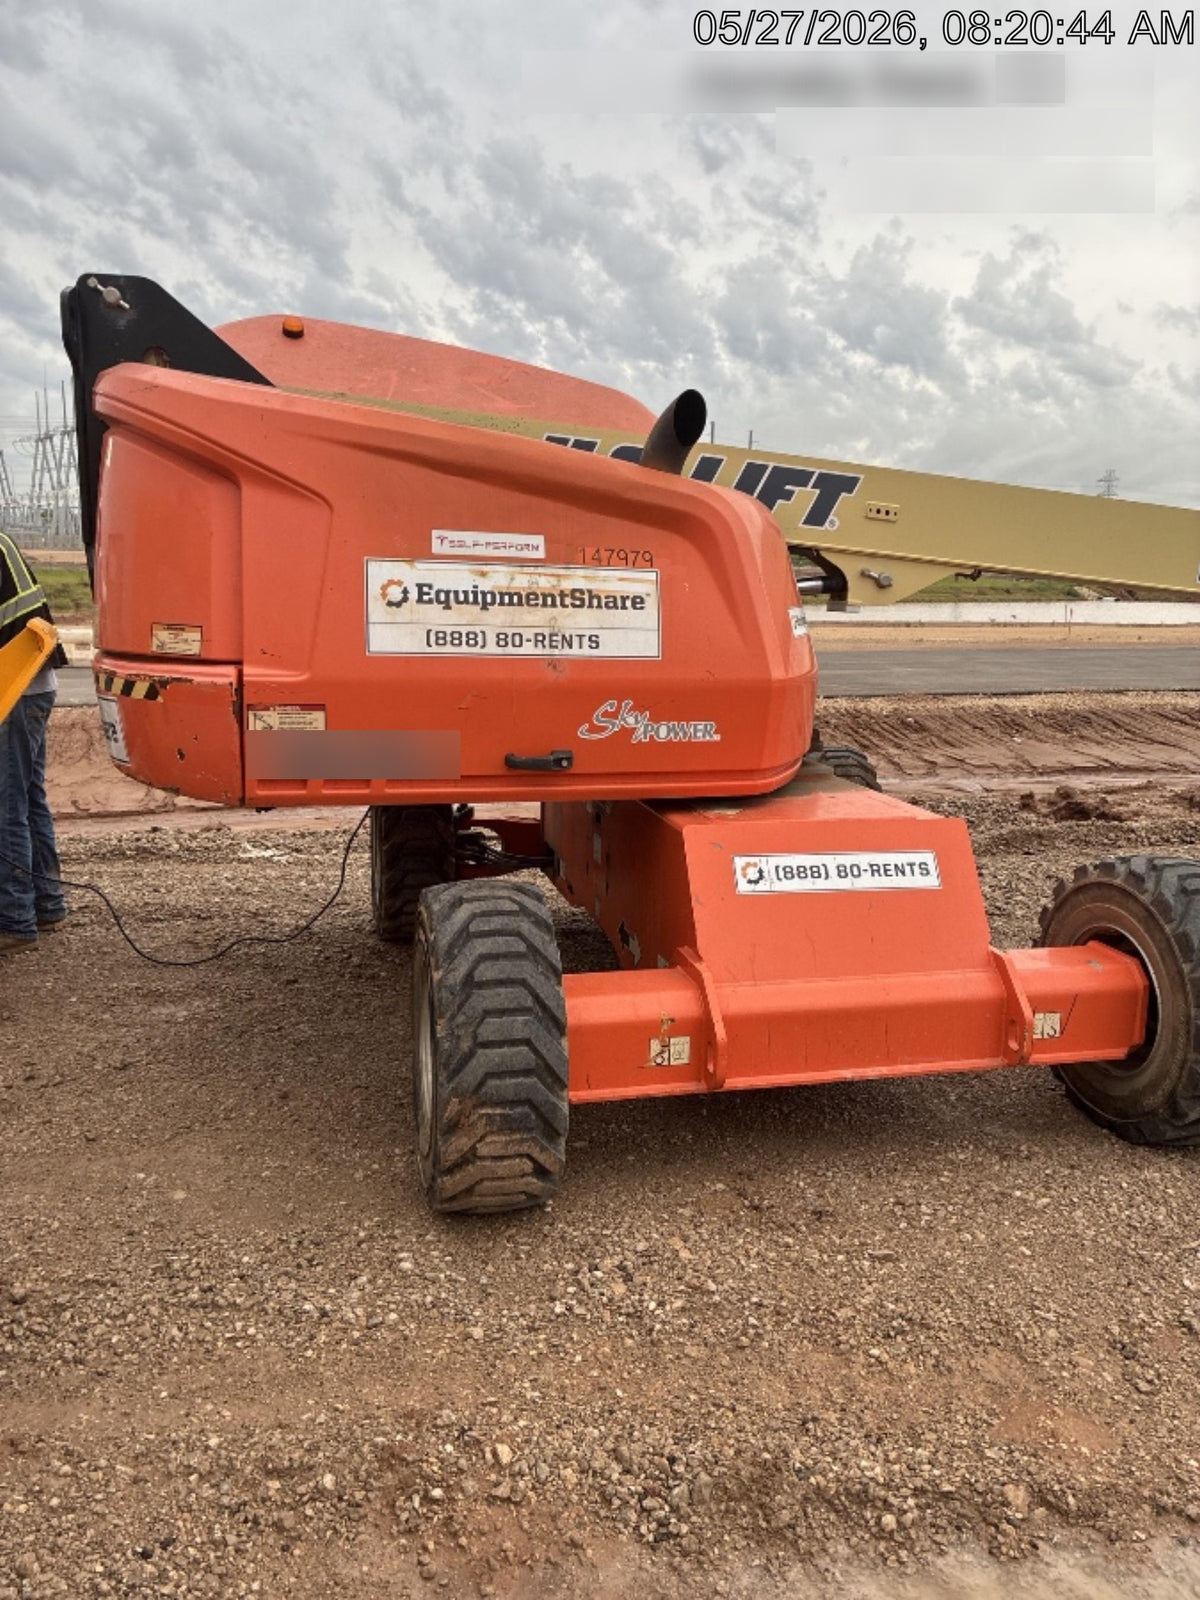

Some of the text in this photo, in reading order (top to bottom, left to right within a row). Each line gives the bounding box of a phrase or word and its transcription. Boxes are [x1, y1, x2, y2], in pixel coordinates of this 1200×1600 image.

[577, 546, 654, 569] 147979
[415, 583, 646, 611] EquipmentShare
[425, 629, 601, 650] (888) 80-RENTS
[774, 861, 931, 881] (888) 80-RENTS
